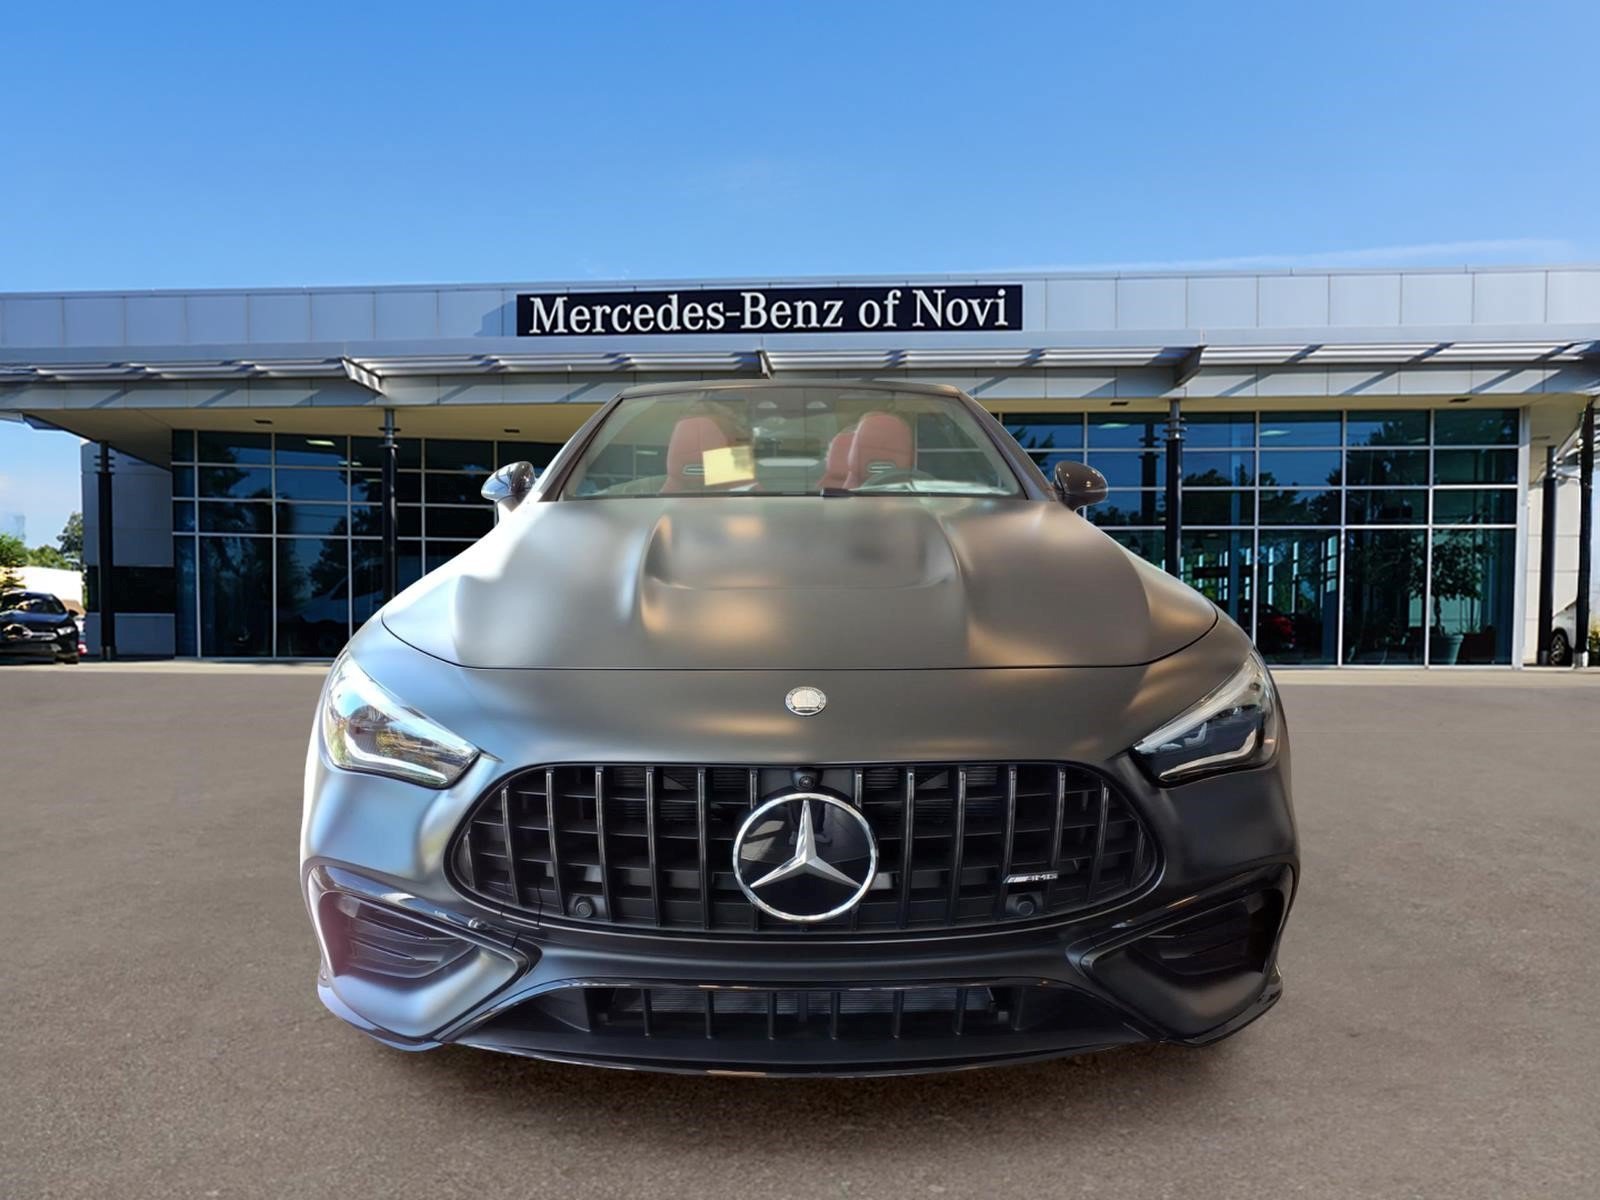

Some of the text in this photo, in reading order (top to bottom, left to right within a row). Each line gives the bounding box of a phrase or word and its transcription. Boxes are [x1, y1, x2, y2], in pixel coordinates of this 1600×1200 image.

[529, 288, 1009, 334] Mercedes-Benz of Novi
